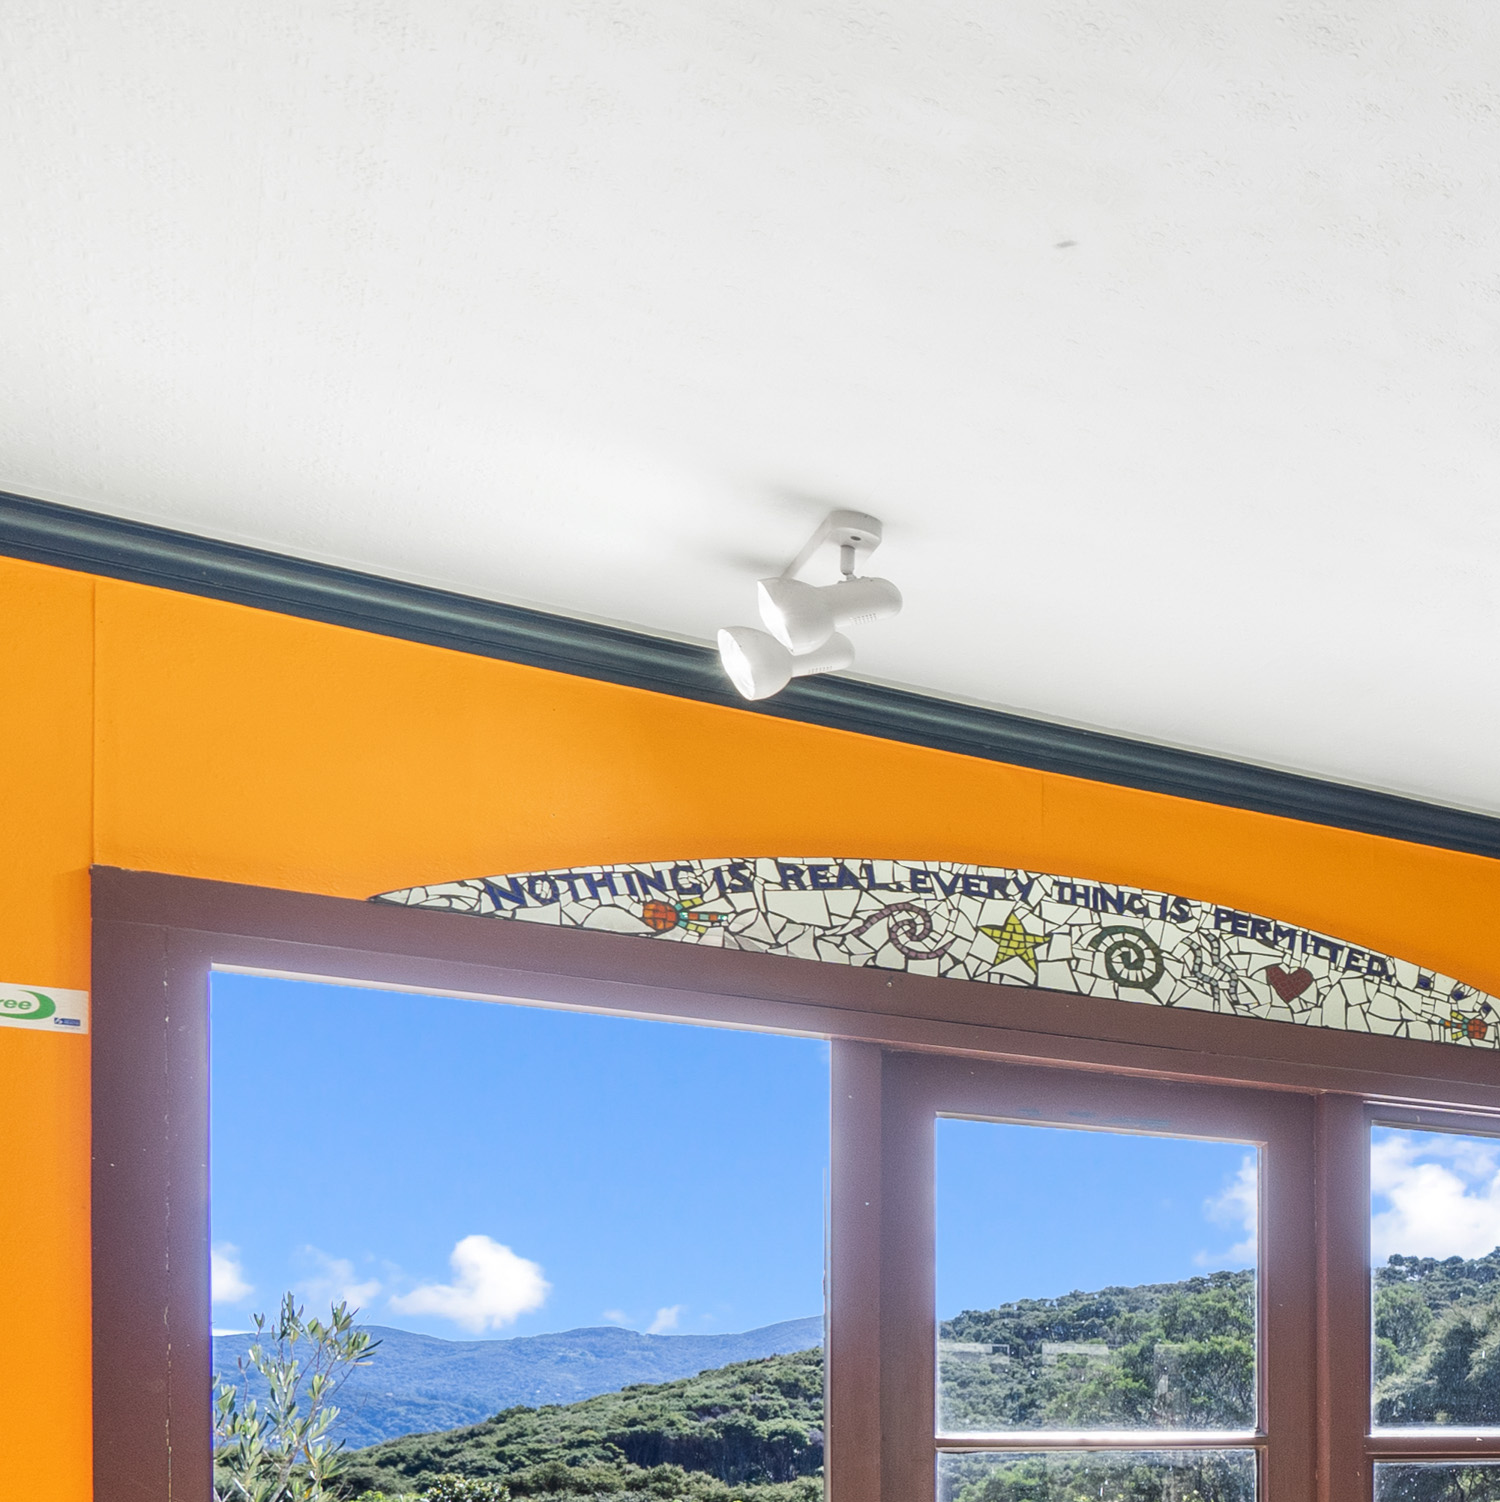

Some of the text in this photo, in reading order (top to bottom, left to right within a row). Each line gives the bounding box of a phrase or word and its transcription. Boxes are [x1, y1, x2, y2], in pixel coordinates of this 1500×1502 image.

[484, 864, 700, 907] NOTHING
[711, 863, 753, 894] IS
[776, 863, 880, 891] REAL
[1152, 894, 1192, 924] IS
[1214, 906, 1395, 983] PERMITTED.
